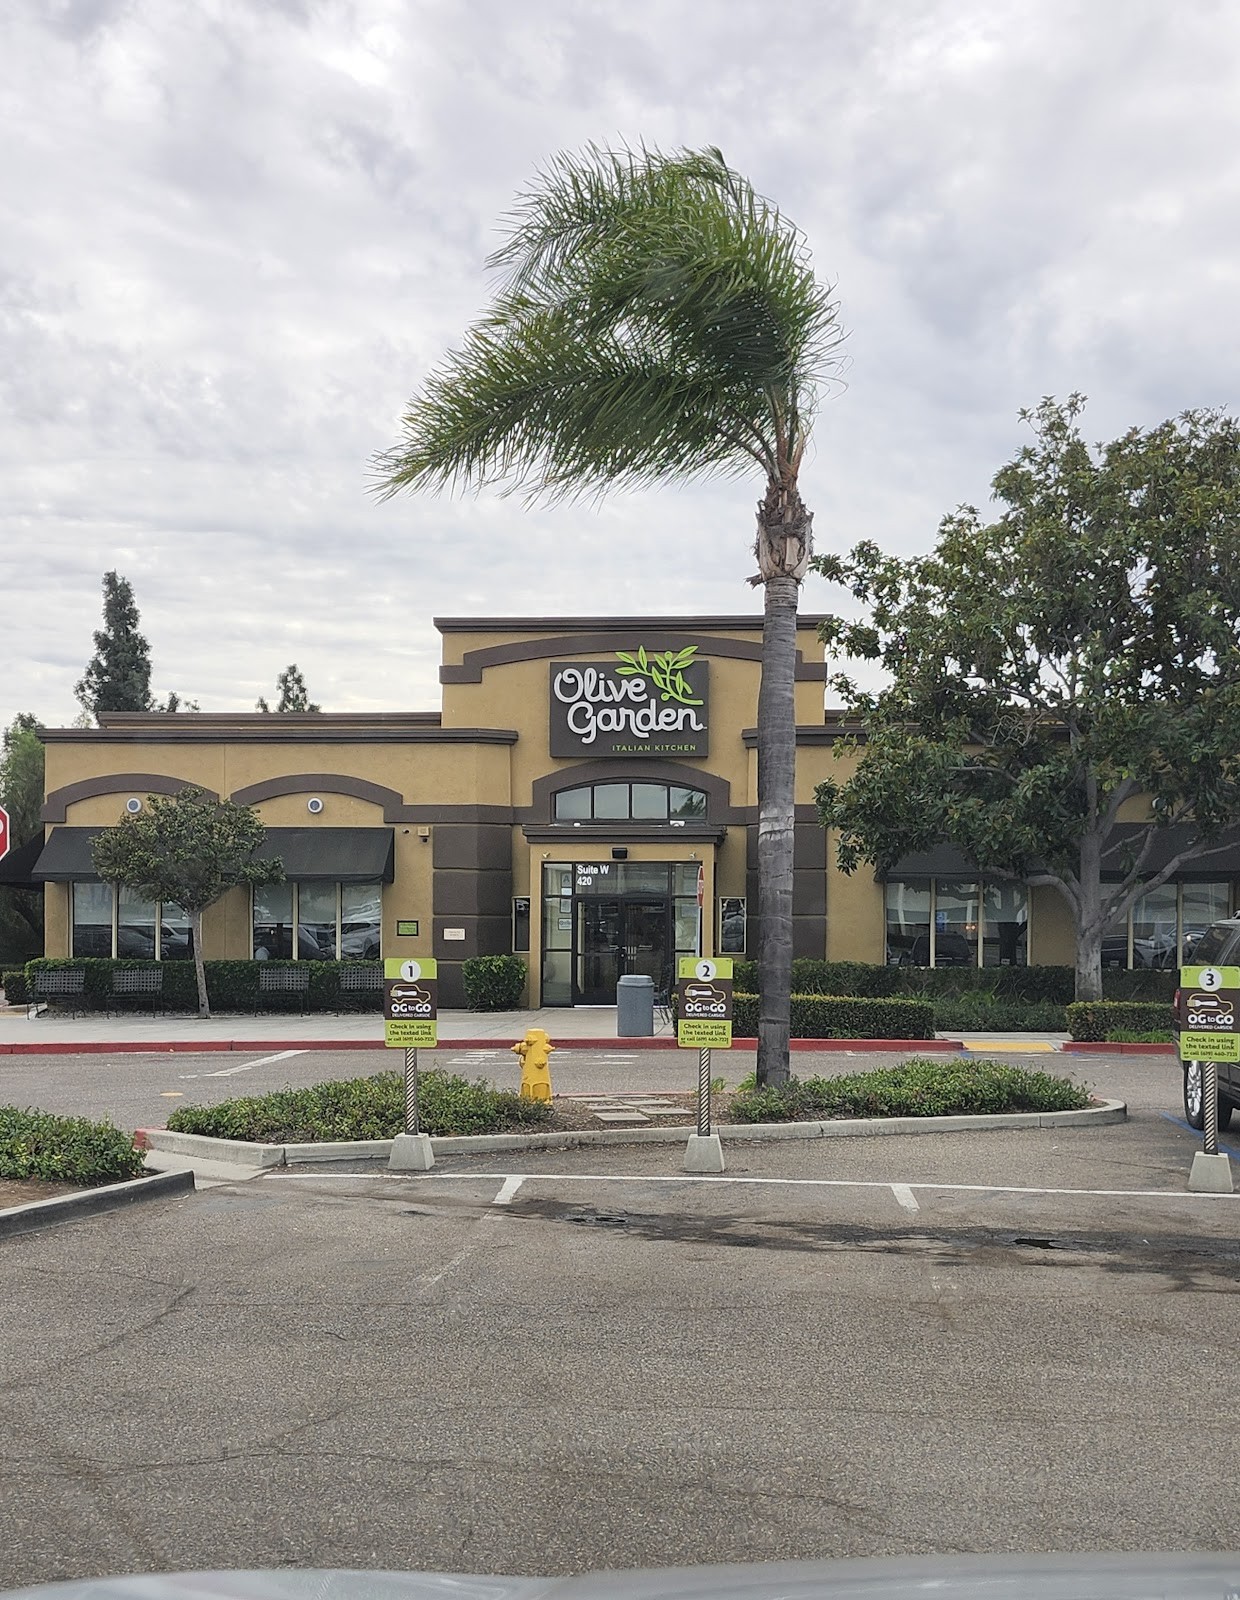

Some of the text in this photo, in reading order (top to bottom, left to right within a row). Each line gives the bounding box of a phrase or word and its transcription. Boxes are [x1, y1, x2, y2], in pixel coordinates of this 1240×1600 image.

[553, 667, 648, 704] Olive
[567, 698, 704, 744] Garden
[577, 865, 609, 875] Suite W
[577, 876, 592, 886] 420
[408, 966, 413, 977] 1
[702, 965, 710, 977] 2
[1206, 973, 1214, 986] 3
[416, 1023, 432, 1031] using
[1216, 1037, 1235, 1045] using
